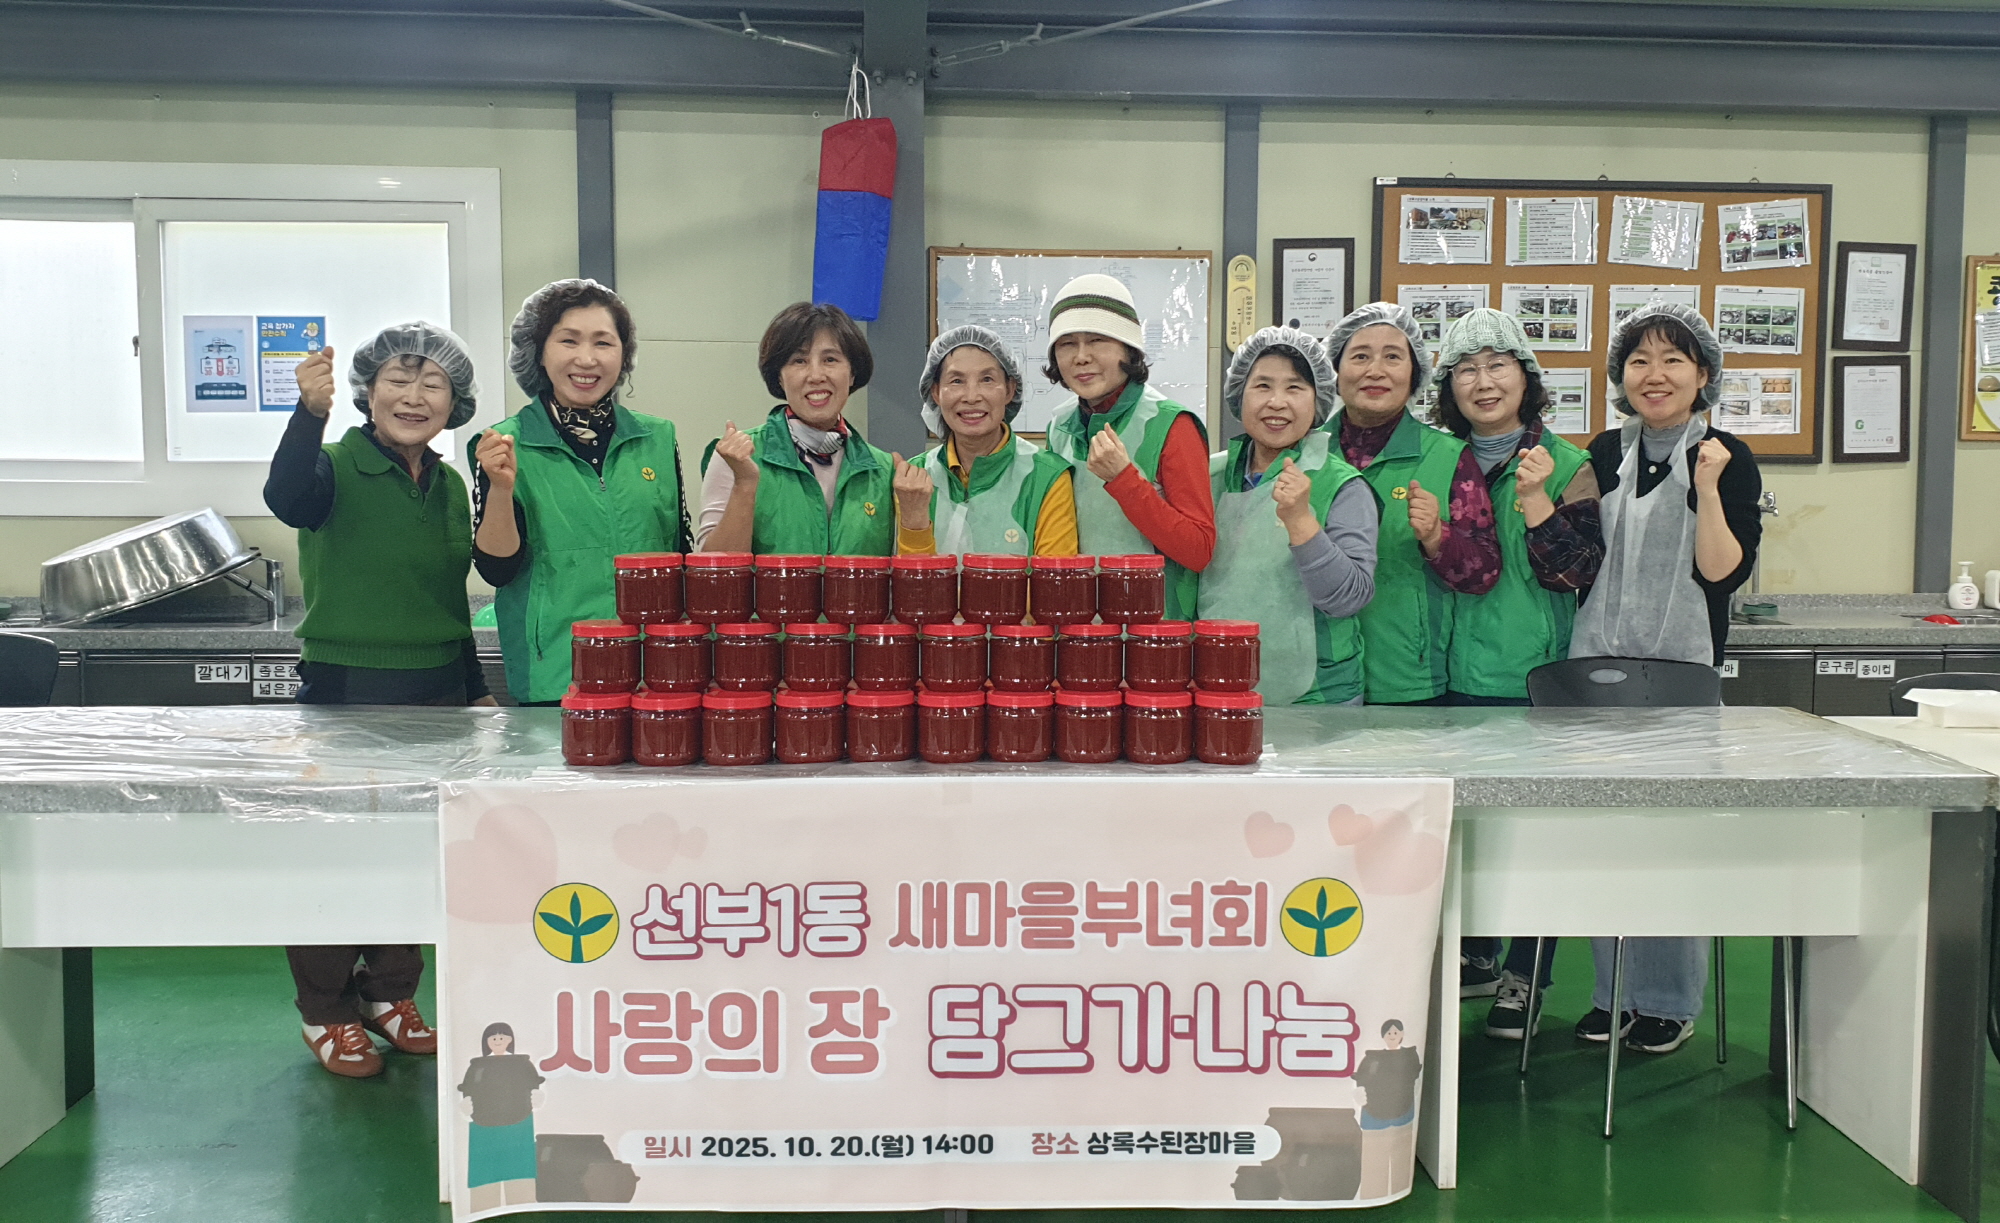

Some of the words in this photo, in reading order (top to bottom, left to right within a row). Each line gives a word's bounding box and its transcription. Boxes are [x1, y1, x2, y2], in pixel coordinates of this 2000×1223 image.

[197, 665, 249, 681] 깔대기
[1818, 661, 1855, 674] 문구류
[1861, 664, 1892, 676] 종이컵
[630, 881, 871, 961] 선부1동
[888, 879, 1269, 950] 새마을부녀회
[538, 989, 780, 1076] 사랑의
[807, 987, 891, 1075] 장
[644, 1135, 692, 1159] 일시
[701, 1136, 777, 1158] 2025.
[784, 1136, 823, 1158] 10.
[830, 1133, 915, 1159] 20.(월)
[922, 1133, 995, 1156] 14:00
[1031, 1132, 1080, 1156] 장소
[1087, 1131, 1257, 1155] 상록수된장마을
